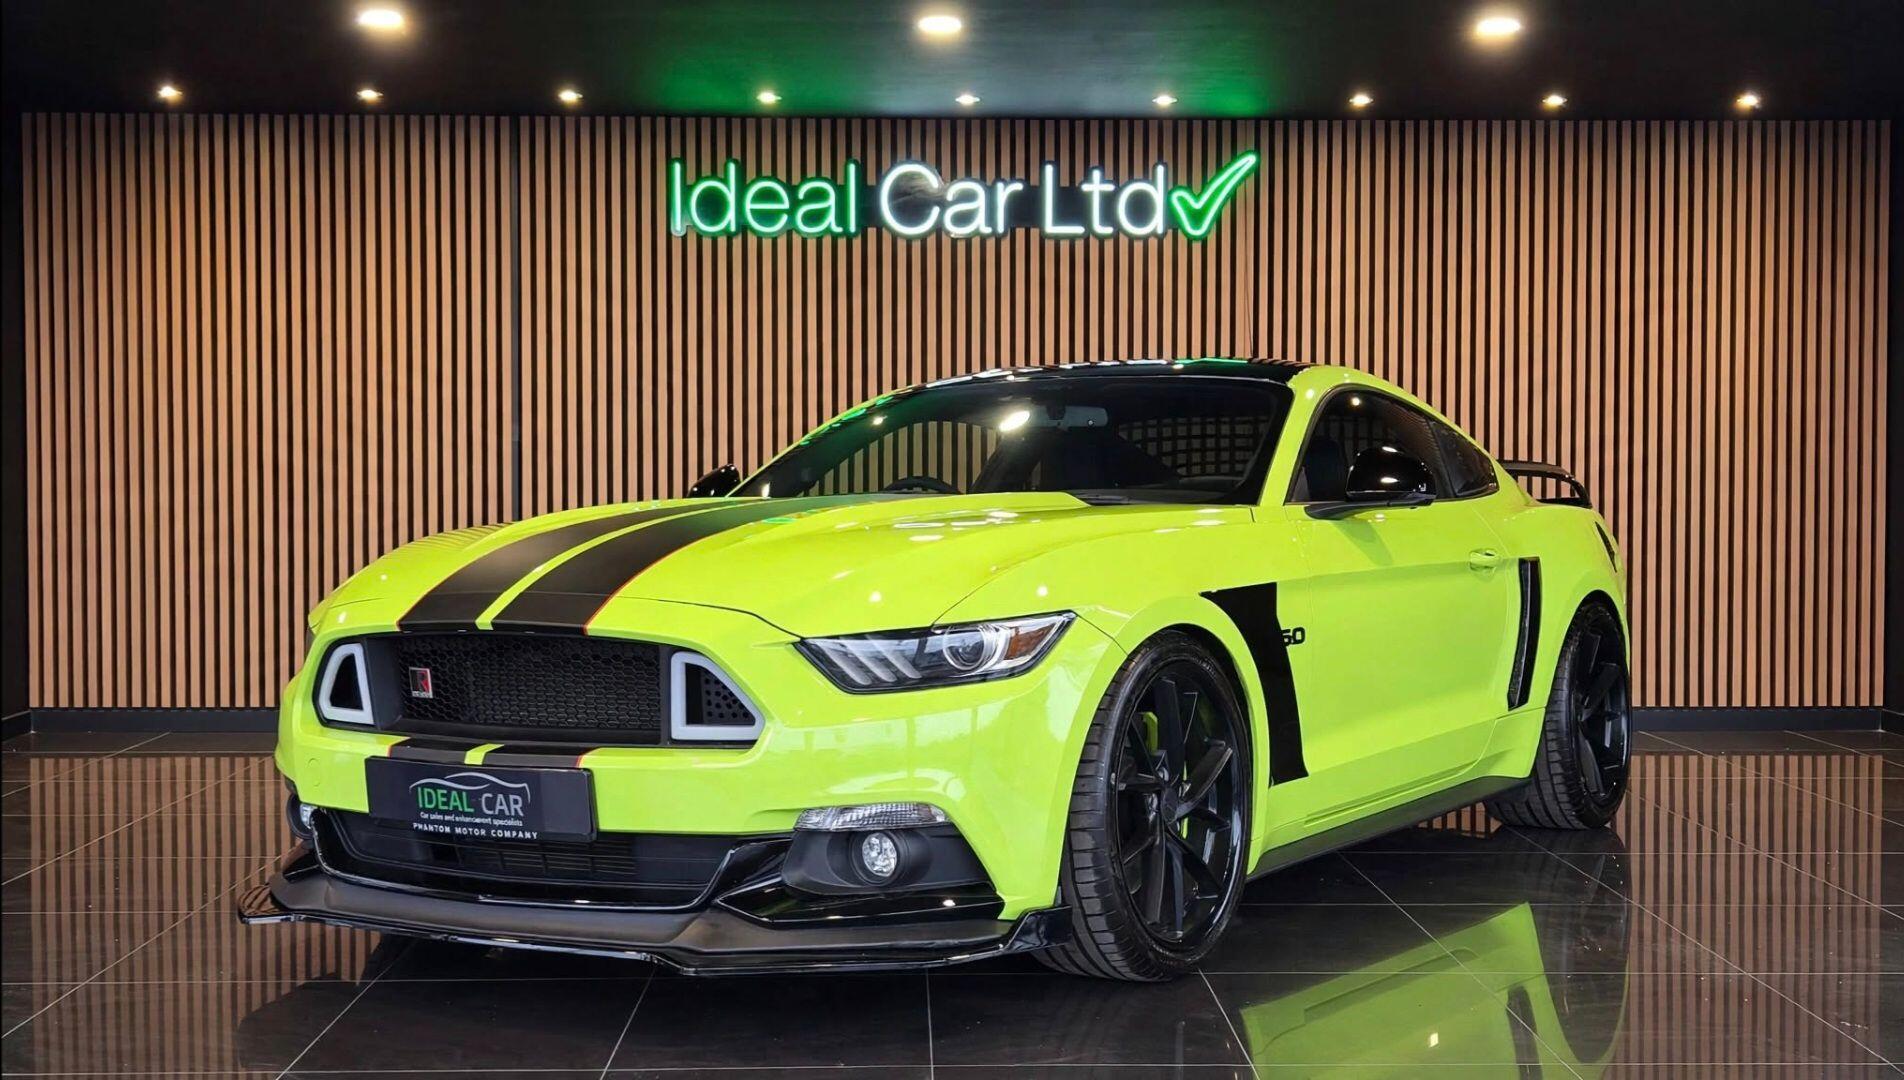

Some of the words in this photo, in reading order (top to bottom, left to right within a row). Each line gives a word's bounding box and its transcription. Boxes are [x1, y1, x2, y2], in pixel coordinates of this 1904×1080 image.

[671, 158, 859, 237] Ideal
[879, 162, 1023, 239] Car
[1042, 162, 1167, 237] Ltd
[417, 786, 475, 812] IDEAL
[481, 792, 524, 817] CAR
[412, 822, 451, 834] PHANTOM
[454, 827, 486, 836] MOTOR
[490, 829, 538, 839] COMPANY
